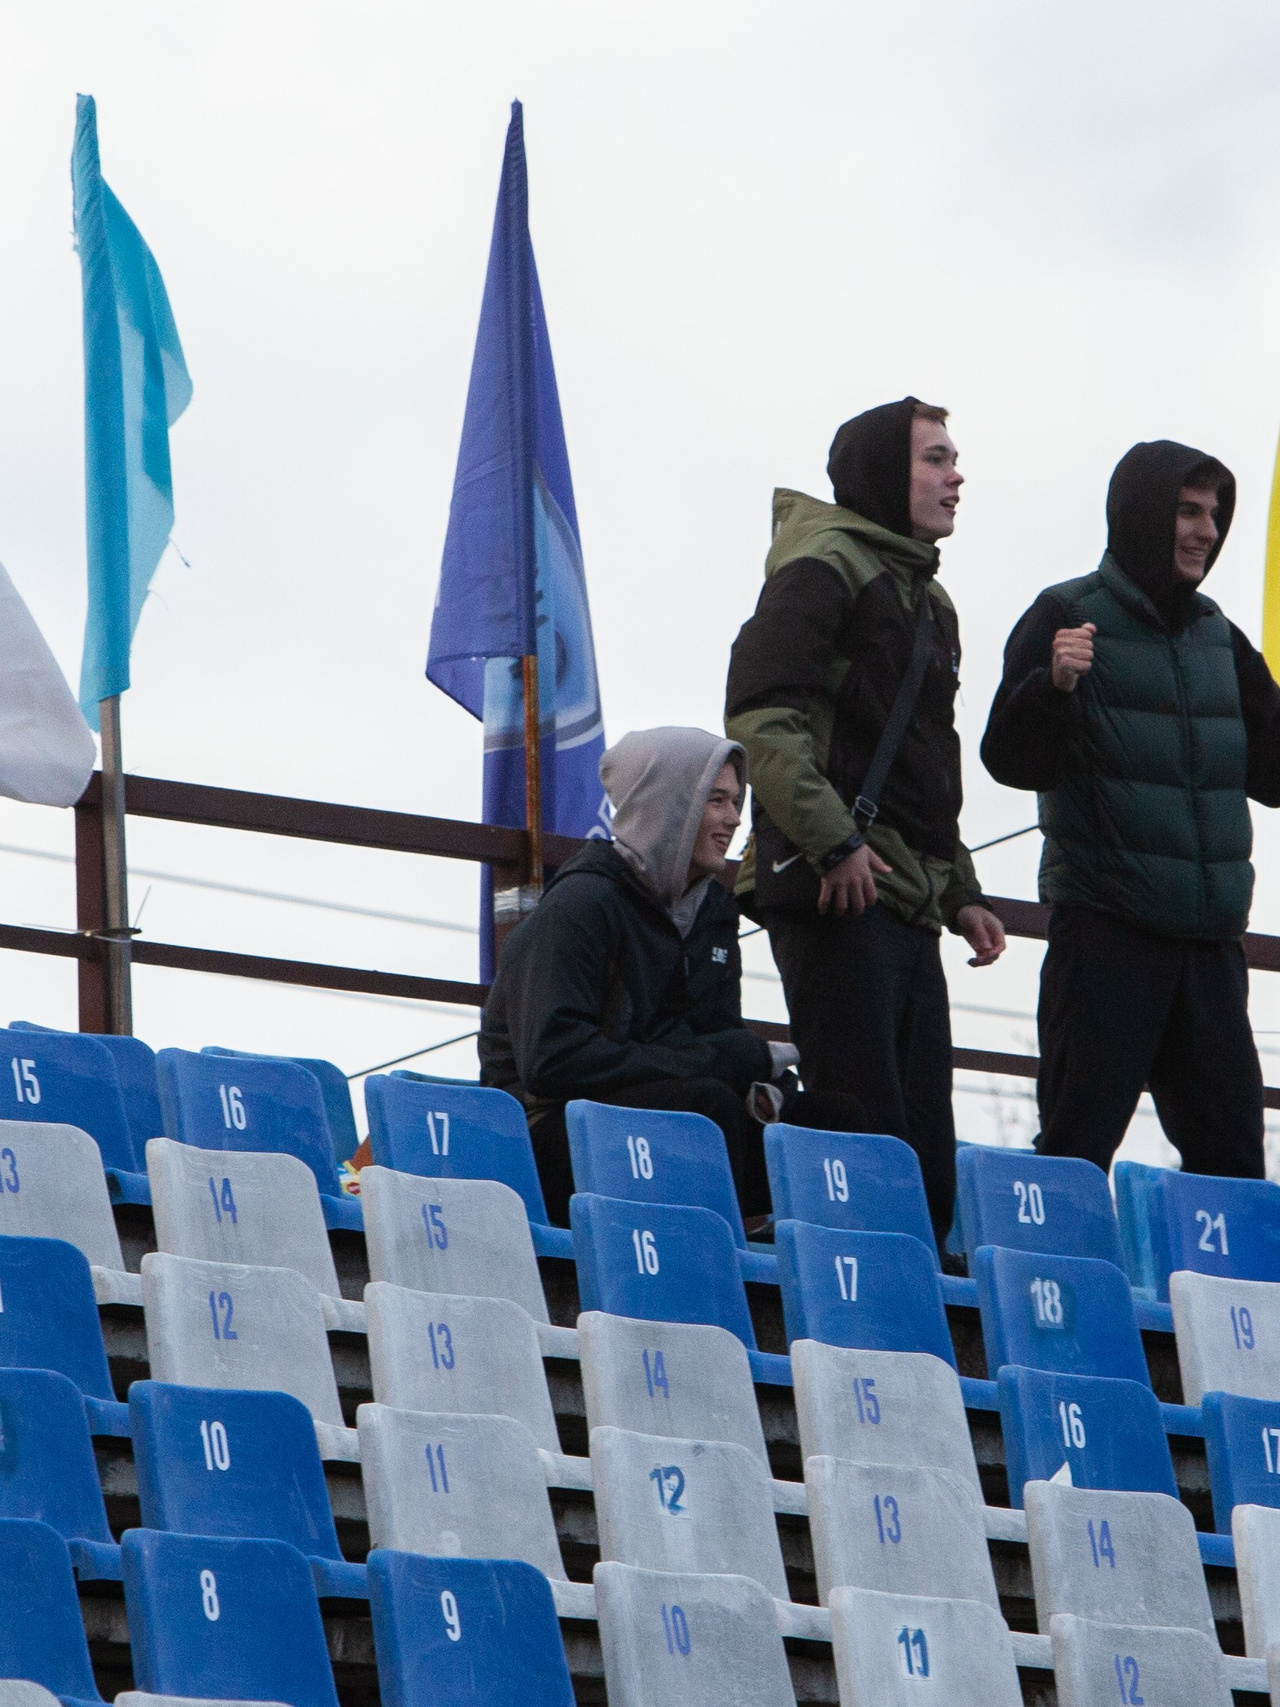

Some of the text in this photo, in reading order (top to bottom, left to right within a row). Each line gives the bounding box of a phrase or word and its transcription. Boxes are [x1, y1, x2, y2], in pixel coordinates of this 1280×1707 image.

[12, 1058, 40, 1104] 15
[219, 1084, 247, 1130] 16
[427, 1111, 449, 1155] 17
[627, 1135, 653, 1179] 18
[823, 1158, 849, 1202] 19
[209, 1178, 237, 1224] 14
[1013, 1181, 1045, 1225] 20
[422, 1204, 448, 1250] 15
[1195, 1209, 1228, 1255] 21
[632, 1229, 659, 1275] 16
[834, 1256, 858, 1301] 17
[1030, 1277, 1063, 1325] 18
[209, 1291, 238, 1340] 12
[1230, 1306, 1255, 1350] 19
[428, 1323, 455, 1370] 13
[642, 1349, 669, 1398] 14
[853, 1378, 881, 1425] 15
[1059, 1401, 1085, 1448] 16
[200, 1420, 230, 1470] 10
[425, 1444, 449, 1493] 11
[650, 1465, 687, 1516] 12
[873, 1495, 901, 1544] 13
[1088, 1520, 1115, 1568] 14
[200, 1569, 220, 1621] 8
[440, 1590, 461, 1641] 9
[661, 1604, 691, 1657] 10
[898, 1627, 929, 1677] 11
[1115, 1655, 1144, 1706] 12
